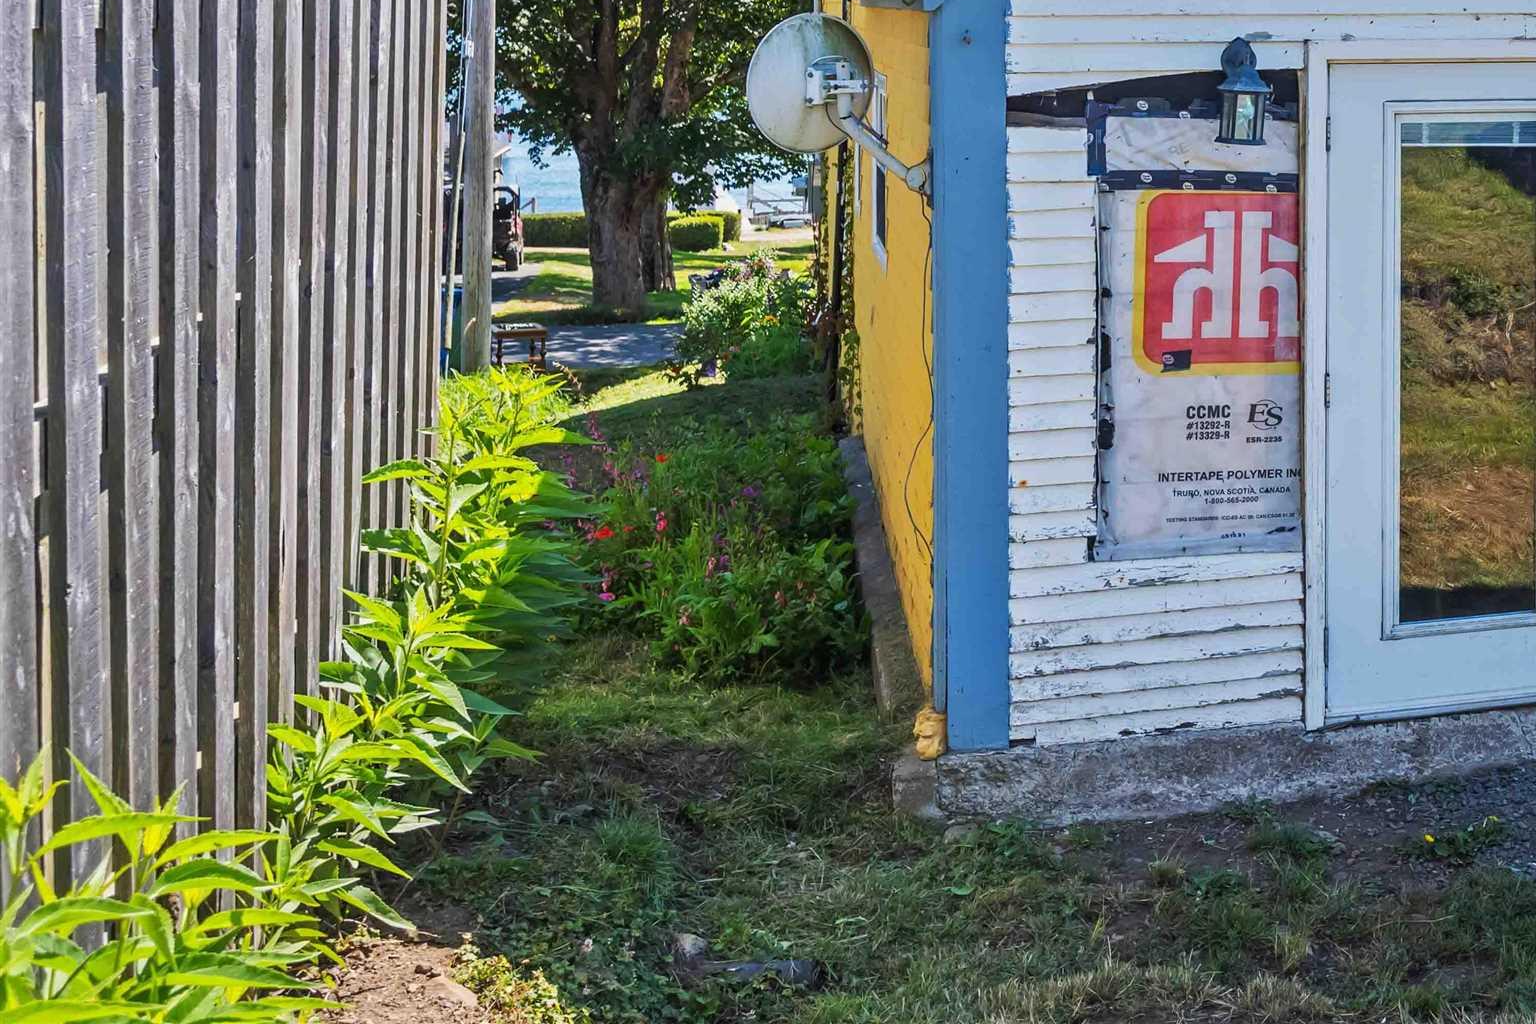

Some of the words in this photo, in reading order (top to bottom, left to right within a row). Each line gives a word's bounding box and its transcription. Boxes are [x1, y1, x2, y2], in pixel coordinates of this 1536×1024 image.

[1185, 404, 1231, 420] CCMC
[1247, 402, 1284, 427] ES
[1185, 421, 1231, 430] #13292-R
[1185, 430, 1230, 440] #13329-R
[1158, 471, 1224, 483] INTERTAPE
[1227, 468, 1283, 480] POLYMER
[1204, 488, 1225, 496] NOVA
[1259, 486, 1291, 495] CANADA
